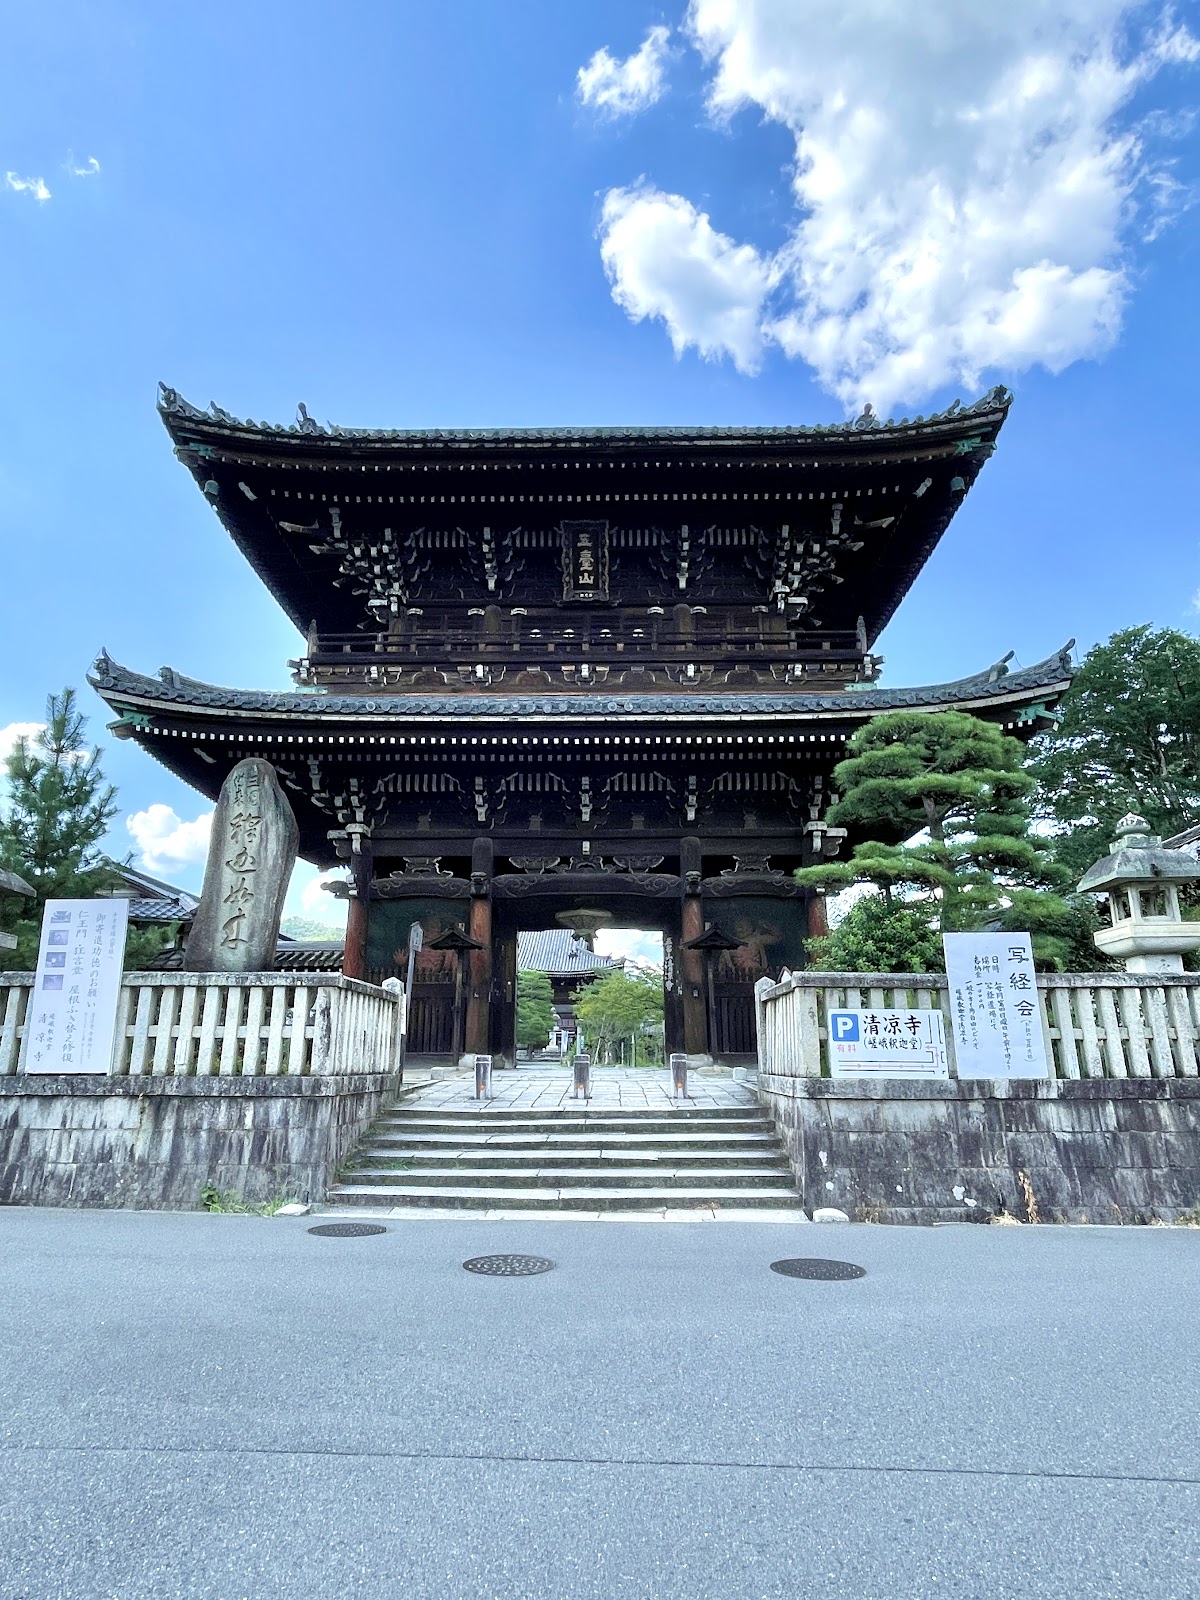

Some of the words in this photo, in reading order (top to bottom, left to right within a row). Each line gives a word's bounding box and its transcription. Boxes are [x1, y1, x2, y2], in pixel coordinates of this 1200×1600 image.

[1007, 946, 1035, 1016] 写経会
[836, 1017, 853, 1038] P
[837, 1044, 856, 1053] 有料
